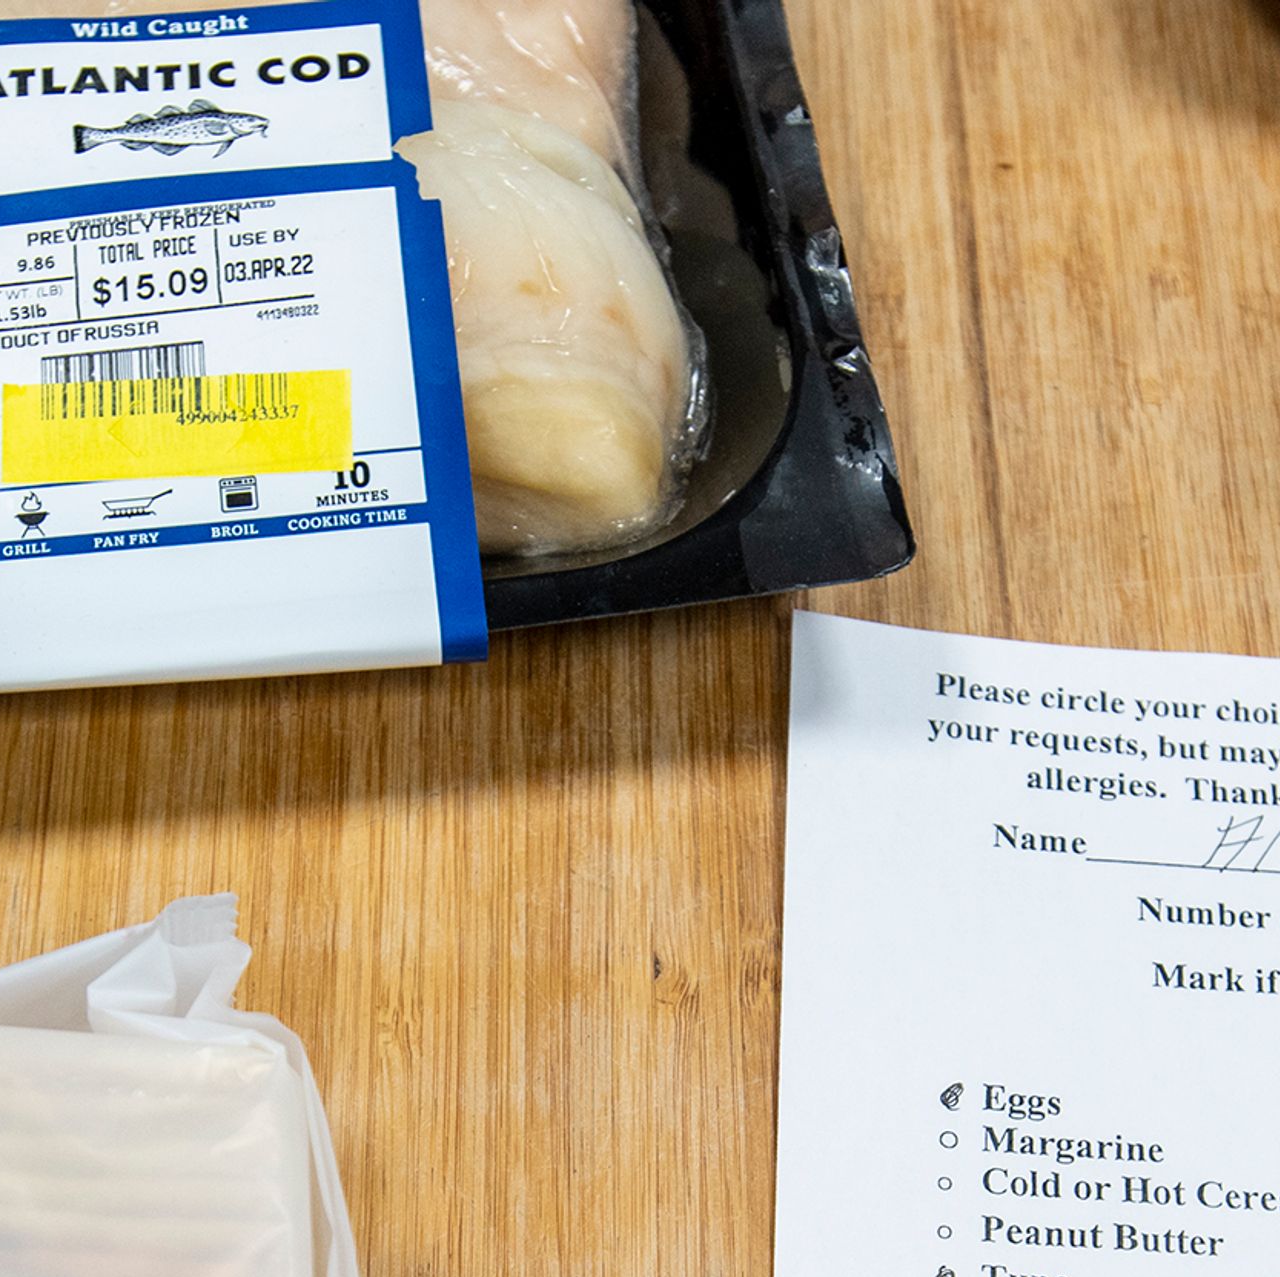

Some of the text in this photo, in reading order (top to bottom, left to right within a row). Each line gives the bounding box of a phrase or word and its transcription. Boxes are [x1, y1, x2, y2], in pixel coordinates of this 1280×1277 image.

[72, 14, 249, 39] Wild Caught
[257, 52, 371, 85] COD
[26, 210, 241, 247] PREVIOUSLY FROZEN
[229, 228, 301, 247] USE BY
[17, 256, 55, 272] 9.86
[98, 235, 197, 265] TOTAL PRICE
[224, 254, 314, 283] 03.APR.22
[36, 284, 63, 298] (LB)
[92, 267, 209, 308] $15.09
[58, 328, 81, 343] OF
[85, 320, 160, 342] RUSSIA
[334, 460, 371, 490] 10
[316, 489, 390, 508] MINUTES
[211, 524, 259, 538] BROIL
[287, 508, 408, 532] COOKING TIME
[2, 543, 51, 557] GRILL
[93, 532, 160, 549] PAN FRY
[936, 673, 1030, 706] Please
[1041, 687, 1124, 714] circle
[1135, 700, 1206, 721] your
[993, 824, 1087, 855] Name
[1152, 962, 1245, 992] Mark
[1256, 969, 1280, 994] if
[983, 1083, 1060, 1121] Eggs
[982, 1125, 1164, 1165] Margarine
